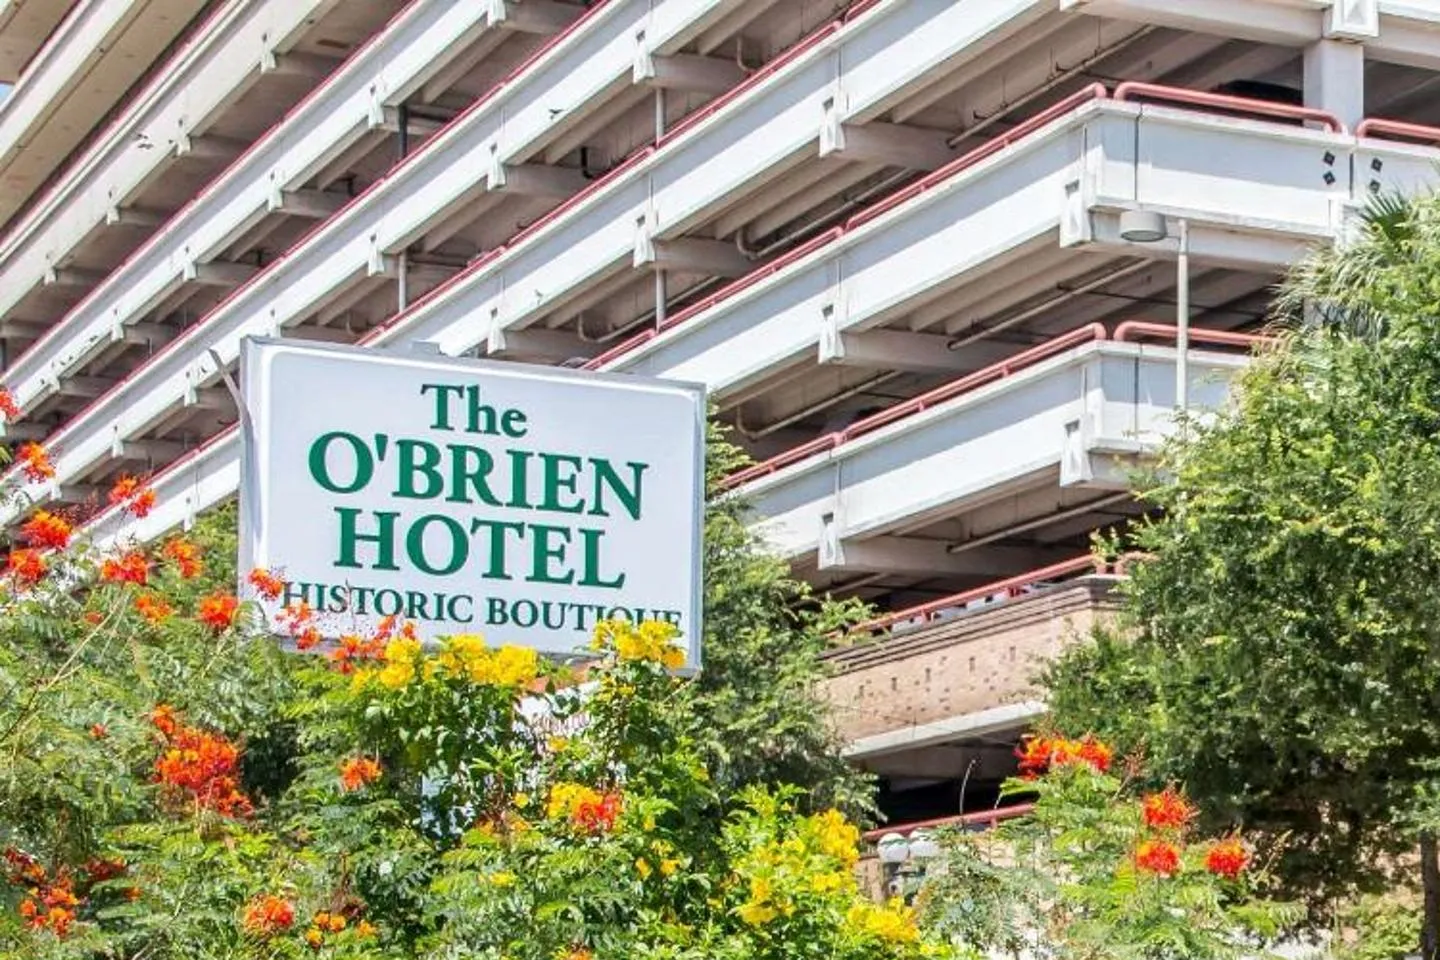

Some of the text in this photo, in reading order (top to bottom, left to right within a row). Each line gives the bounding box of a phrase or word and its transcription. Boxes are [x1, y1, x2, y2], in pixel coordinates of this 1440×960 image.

[420, 383, 528, 438] The
[308, 431, 649, 521] O'BRIEN
[333, 507, 626, 590] HOTEL
[280, 581, 474, 623] HISTORIC
